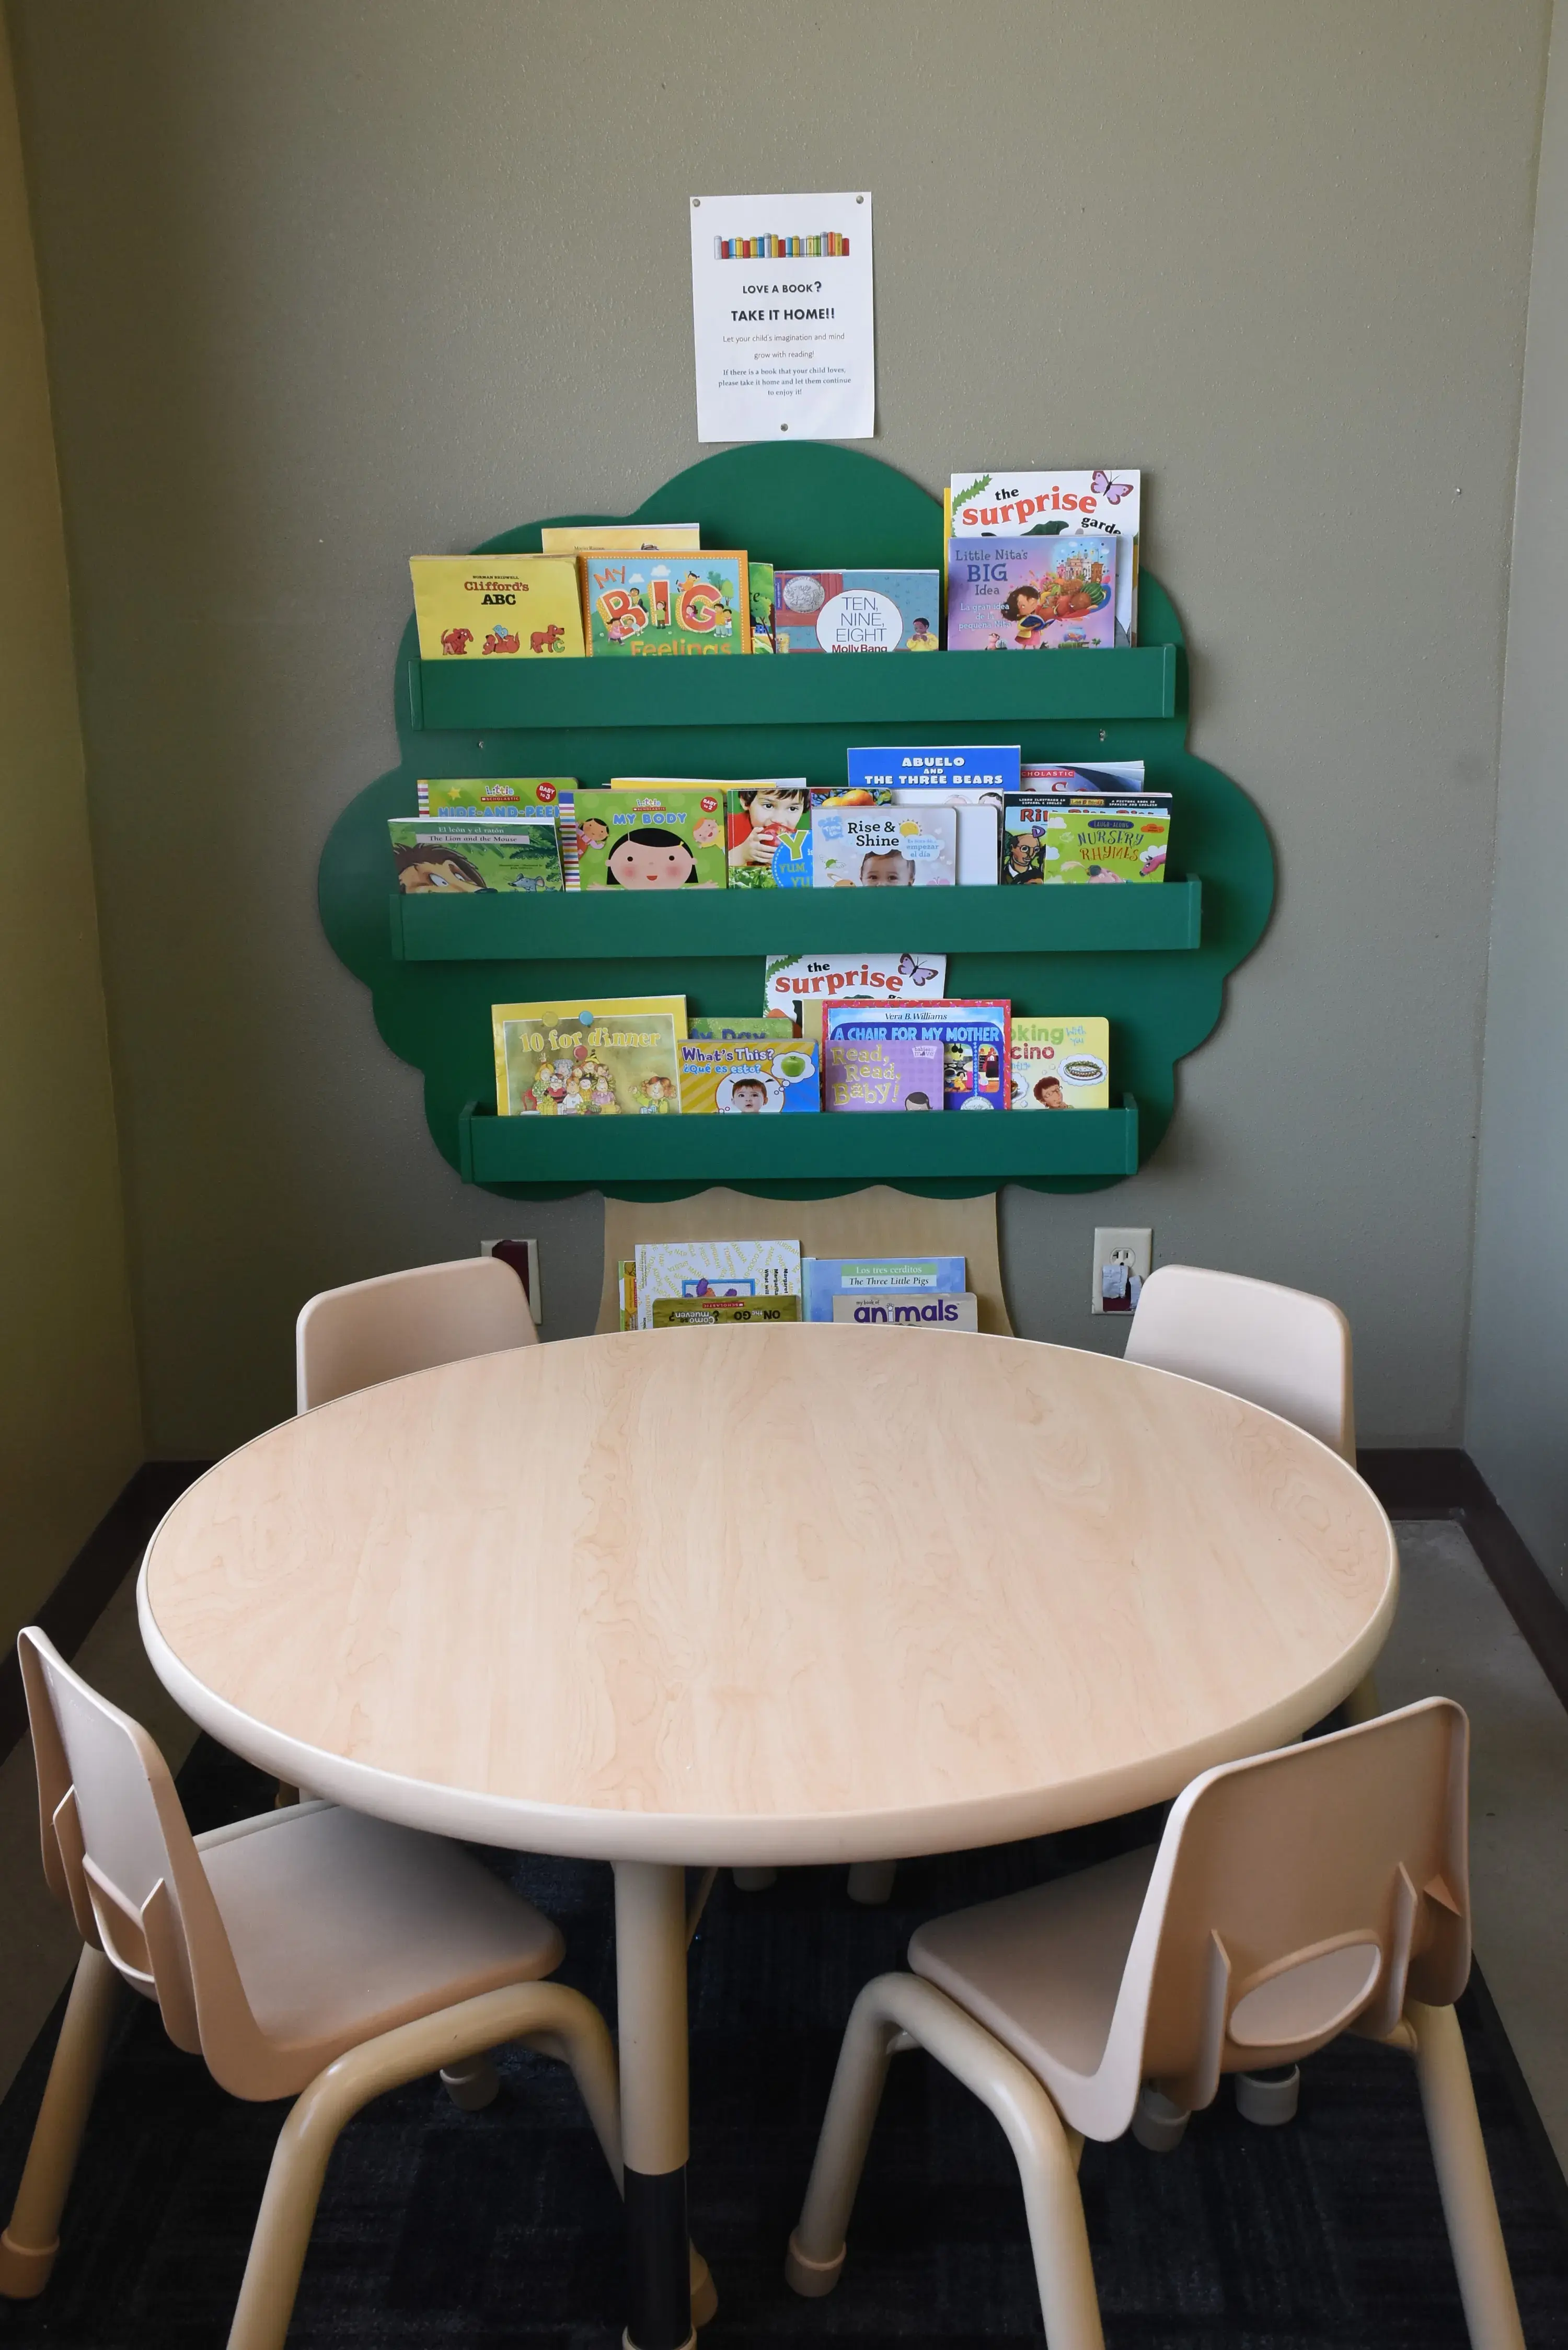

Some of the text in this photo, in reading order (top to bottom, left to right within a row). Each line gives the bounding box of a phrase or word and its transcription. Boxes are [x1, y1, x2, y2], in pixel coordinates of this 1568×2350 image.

[743, 281, 822, 294] LOVE A BOOK?
[731, 308, 835, 321] TAKE IT HOME!!
[995, 489, 1019, 501] the
[963, 486, 1097, 526] surprise
[955, 549, 1028, 561] Little Nita's
[594, 566, 626, 590] MY
[967, 563, 1008, 582] BIG
[464, 581, 529, 591] Clifford's
[975, 584, 999, 595] Idea
[481, 594, 516, 605] ABC
[841, 597, 878, 612] TEN,
[596, 580, 722, 640] BIG
[841, 613, 884, 627] NINE,
[837, 628, 887, 642] EIGHT
[832, 644, 859, 653] Molly
[902, 757, 965, 767] ABUELO
[865, 775, 1003, 785] THE THREE BEARS
[485, 784, 514, 796] Little
[539, 786, 555, 794] BABY
[636, 798, 661, 807] Little
[613, 813, 687, 825] MY BODY
[848, 821, 895, 834] Rise &
[777, 830, 809, 860] Y
[856, 834, 899, 846] Shine
[1078, 830, 1144, 848] NURSERY
[1079, 846, 1139, 861] RHYMES
[779, 863, 808, 873] YUM,
[807, 961, 831, 973] the
[775, 964, 903, 995] surprise
[519, 1027, 660, 1052] 10 for dinner
[835, 1027, 999, 1041] A CHAIR FOR MY MOTHER
[682, 1046, 775, 1062] What's This?
[831, 1044, 890, 1066] Read,
[683, 1064, 711, 1075] ¿Qué
[730, 1064, 762, 1074] esto?
[845, 1063, 901, 1082] Read,
[832, 1082, 900, 1105] Baby!
[890, 1265, 922, 1274] cerditos
[913, 1277, 929, 1286] Pigs
[734, 1310, 751, 1320] GO
[764, 1310, 780, 1319] ON
[854, 1299, 959, 1323] animals
